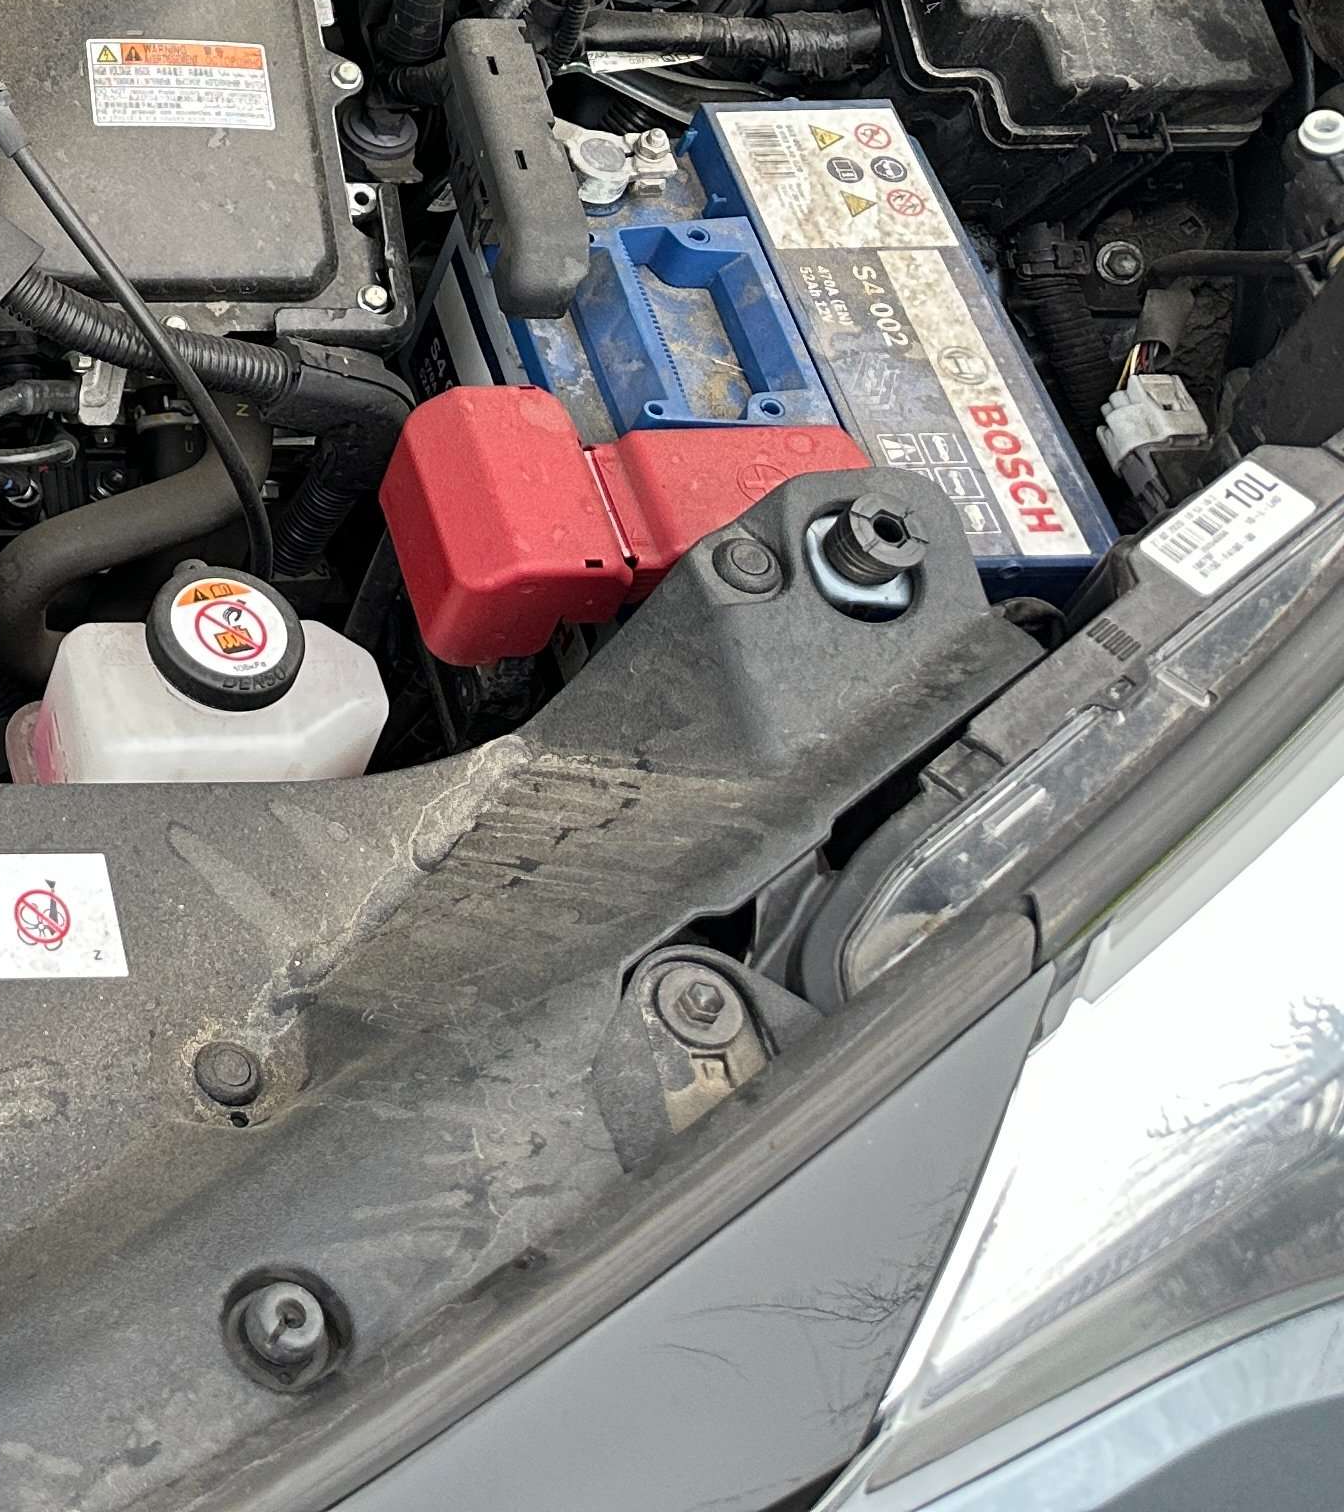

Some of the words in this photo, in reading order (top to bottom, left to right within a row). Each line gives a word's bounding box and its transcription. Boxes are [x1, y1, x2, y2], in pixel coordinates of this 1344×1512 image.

[799, 266, 822, 297] 52Ah
[814, 300, 834, 323] 12V
[817, 265, 839, 297] 470A
[852, 265, 885, 296] S4
[869, 302, 909, 347] 002
[968, 404, 1064, 532] BOSCH
[1224, 473, 1279, 509] 10L
[222, 667, 287, 691] DENSO
[93, 949, 103, 960] Z
